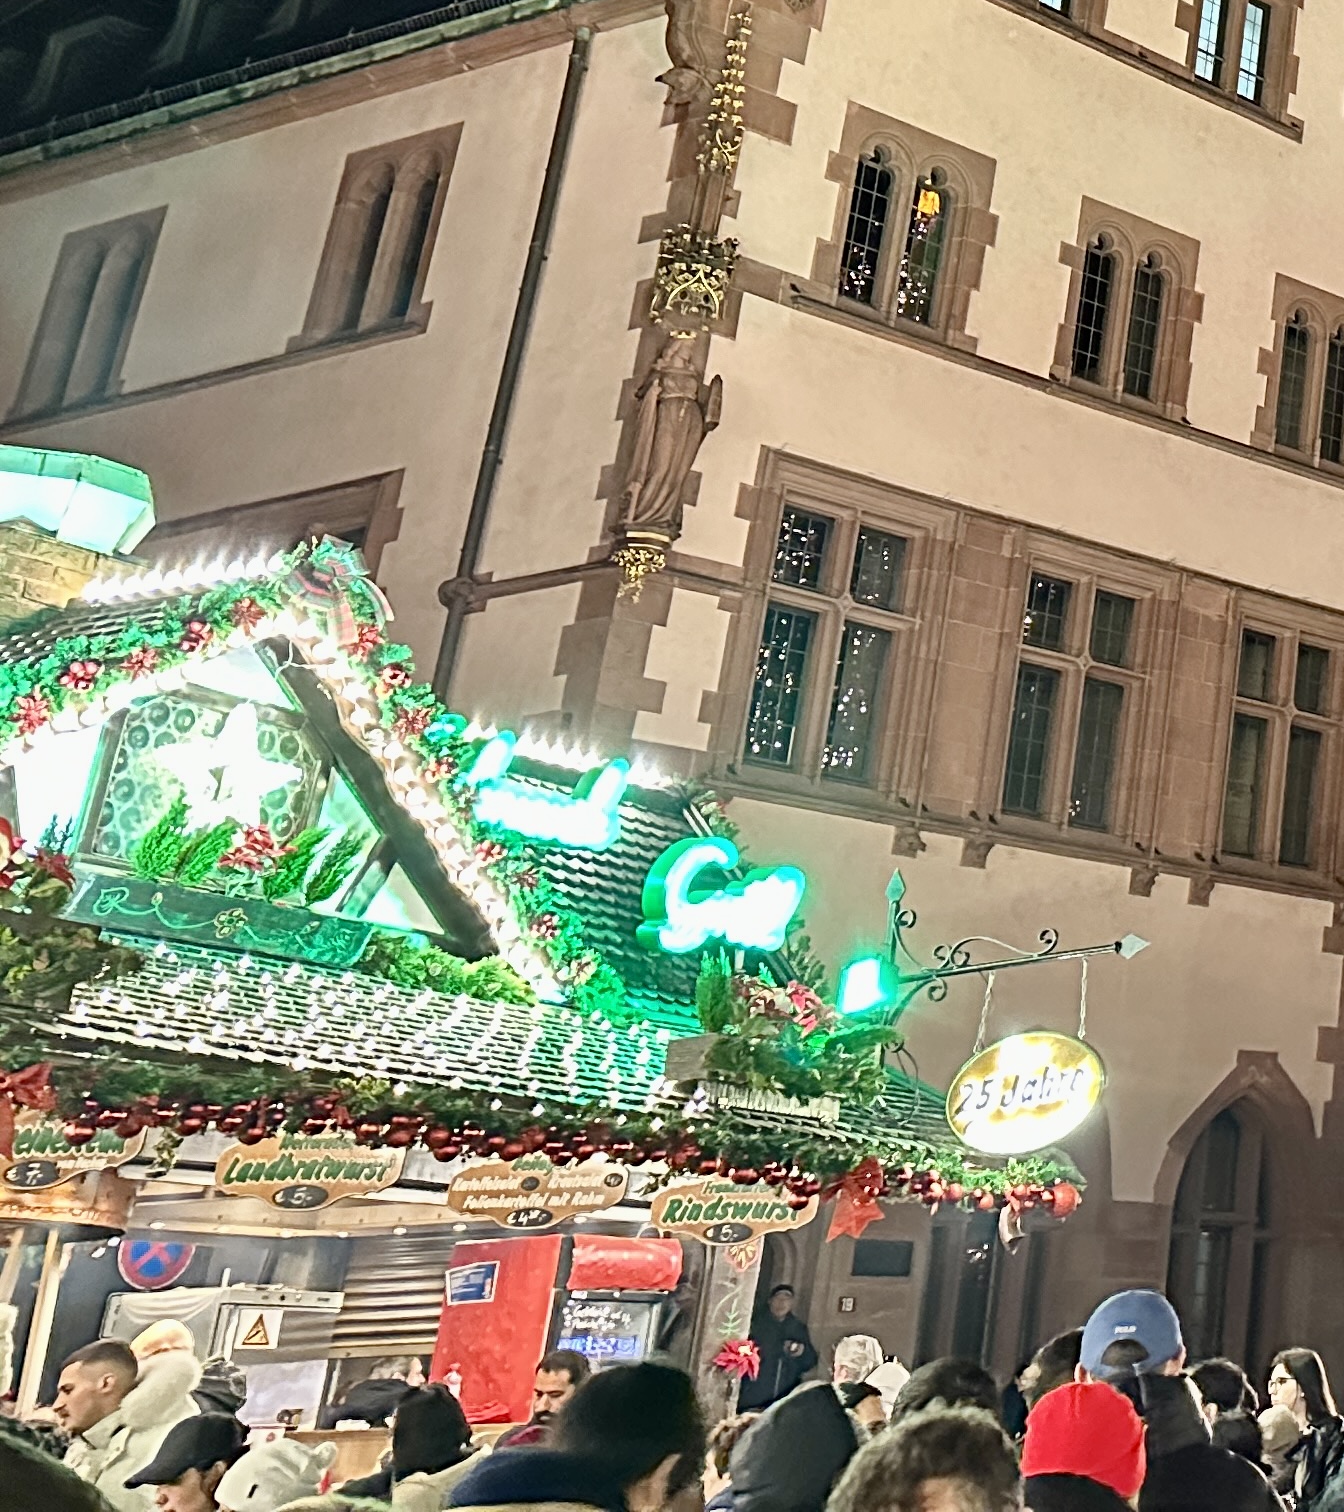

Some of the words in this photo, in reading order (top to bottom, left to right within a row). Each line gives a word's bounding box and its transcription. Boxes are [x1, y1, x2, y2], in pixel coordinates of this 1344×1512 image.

[953, 1079, 994, 1115] 25
[1000, 1066, 1084, 1108] Jahre
[222, 1153, 396, 1185] Landbratwurst
[661, 1195, 800, 1224] Rindswurst
[841, 1297, 854, 1312] 19
